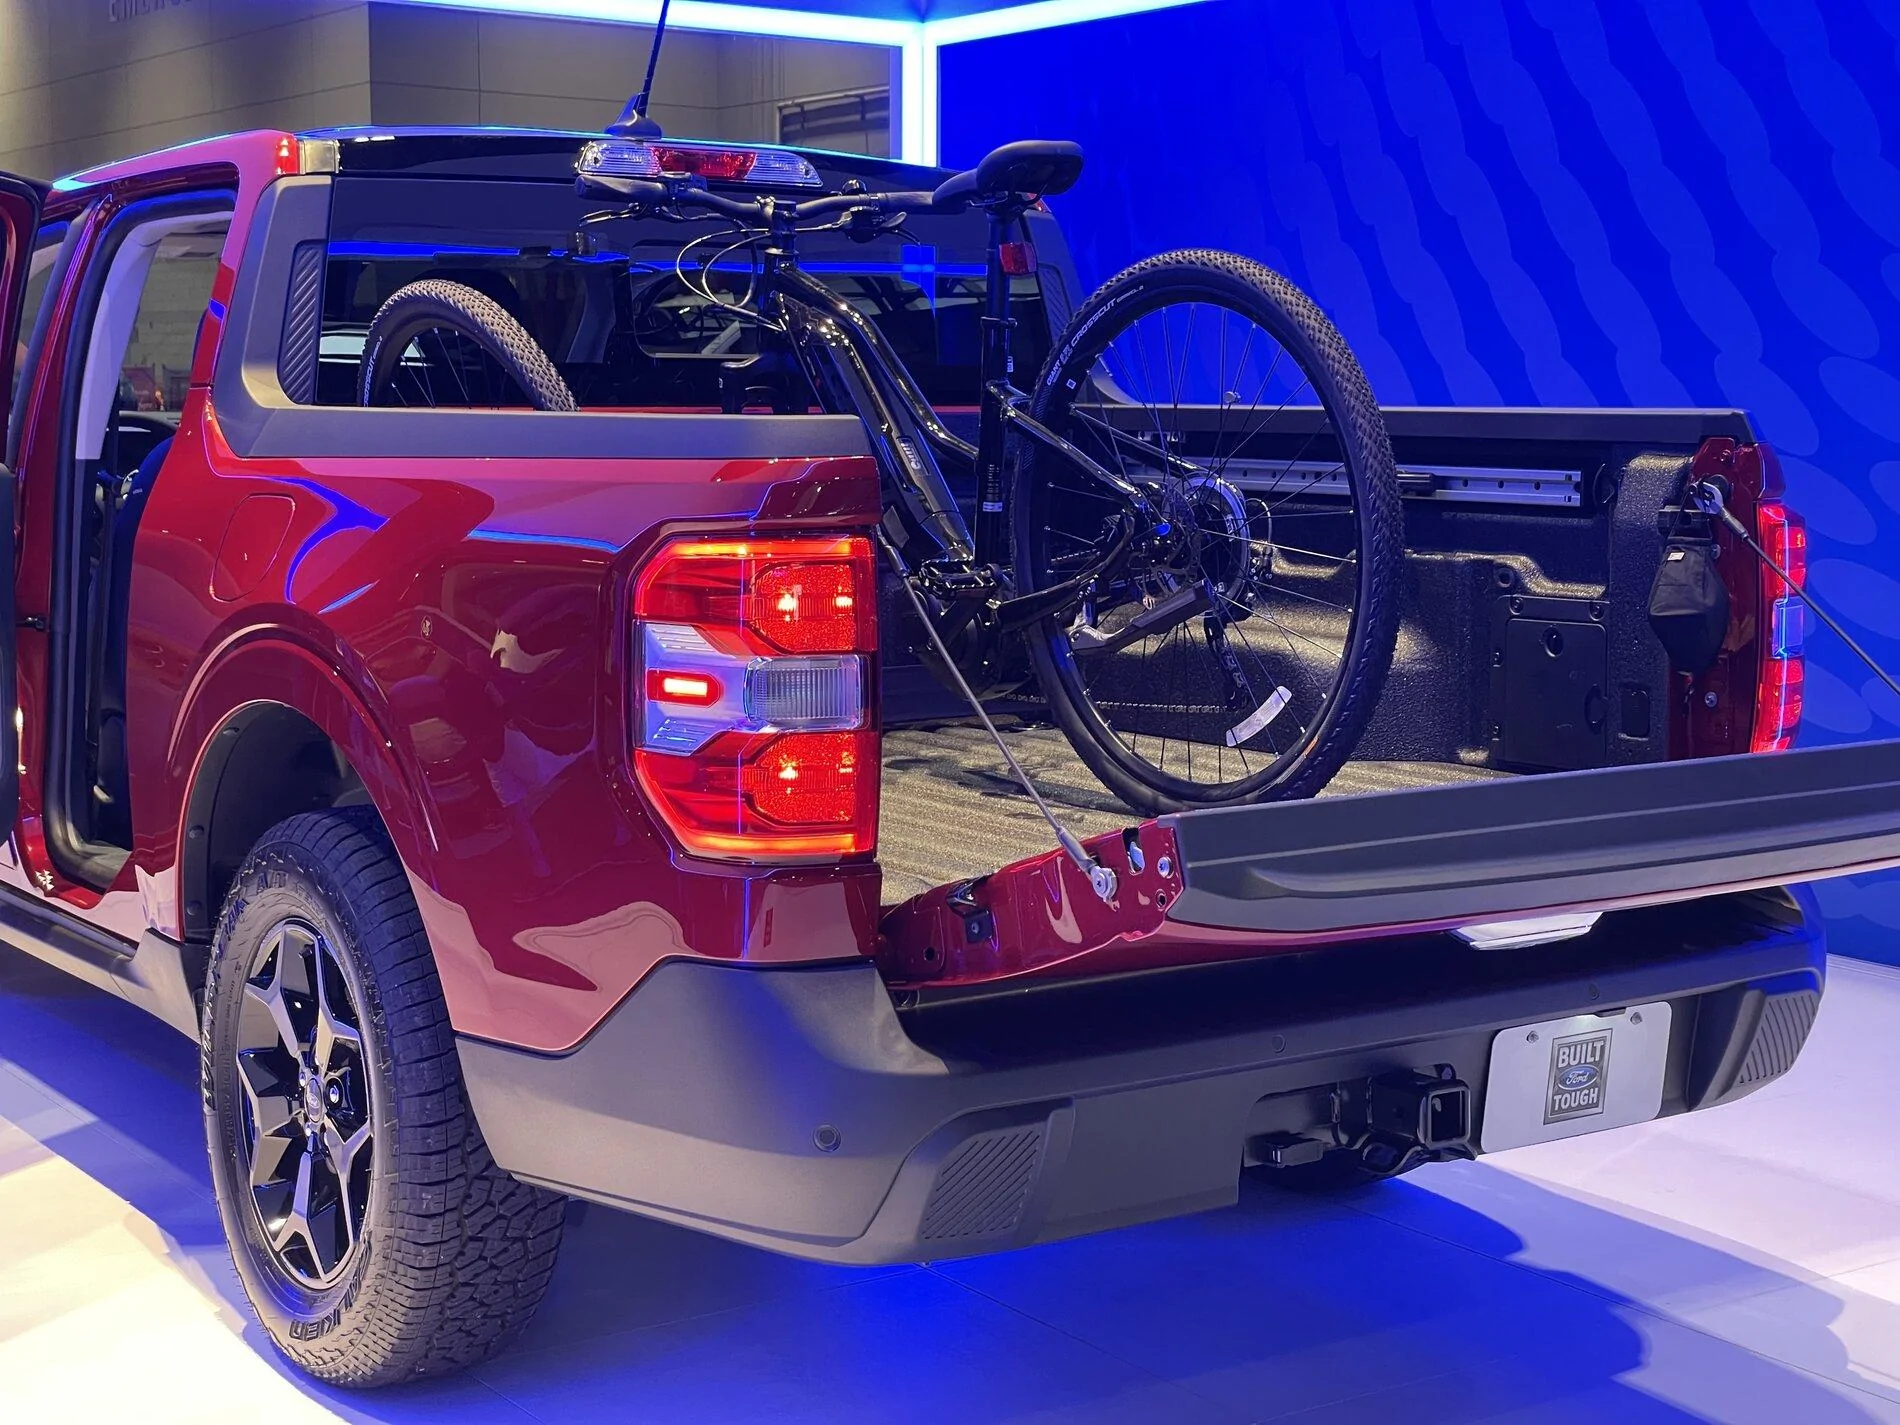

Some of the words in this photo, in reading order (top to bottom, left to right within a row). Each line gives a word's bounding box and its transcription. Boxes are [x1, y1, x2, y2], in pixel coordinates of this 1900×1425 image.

[1047, 359, 1061, 386] GIANT
[1071, 298, 1116, 347] CROSSCUT
[1558, 1040, 1604, 1068] BUILT
[1566, 1070, 1589, 1085] Ford
[1554, 1088, 1598, 1111] TOUGH
